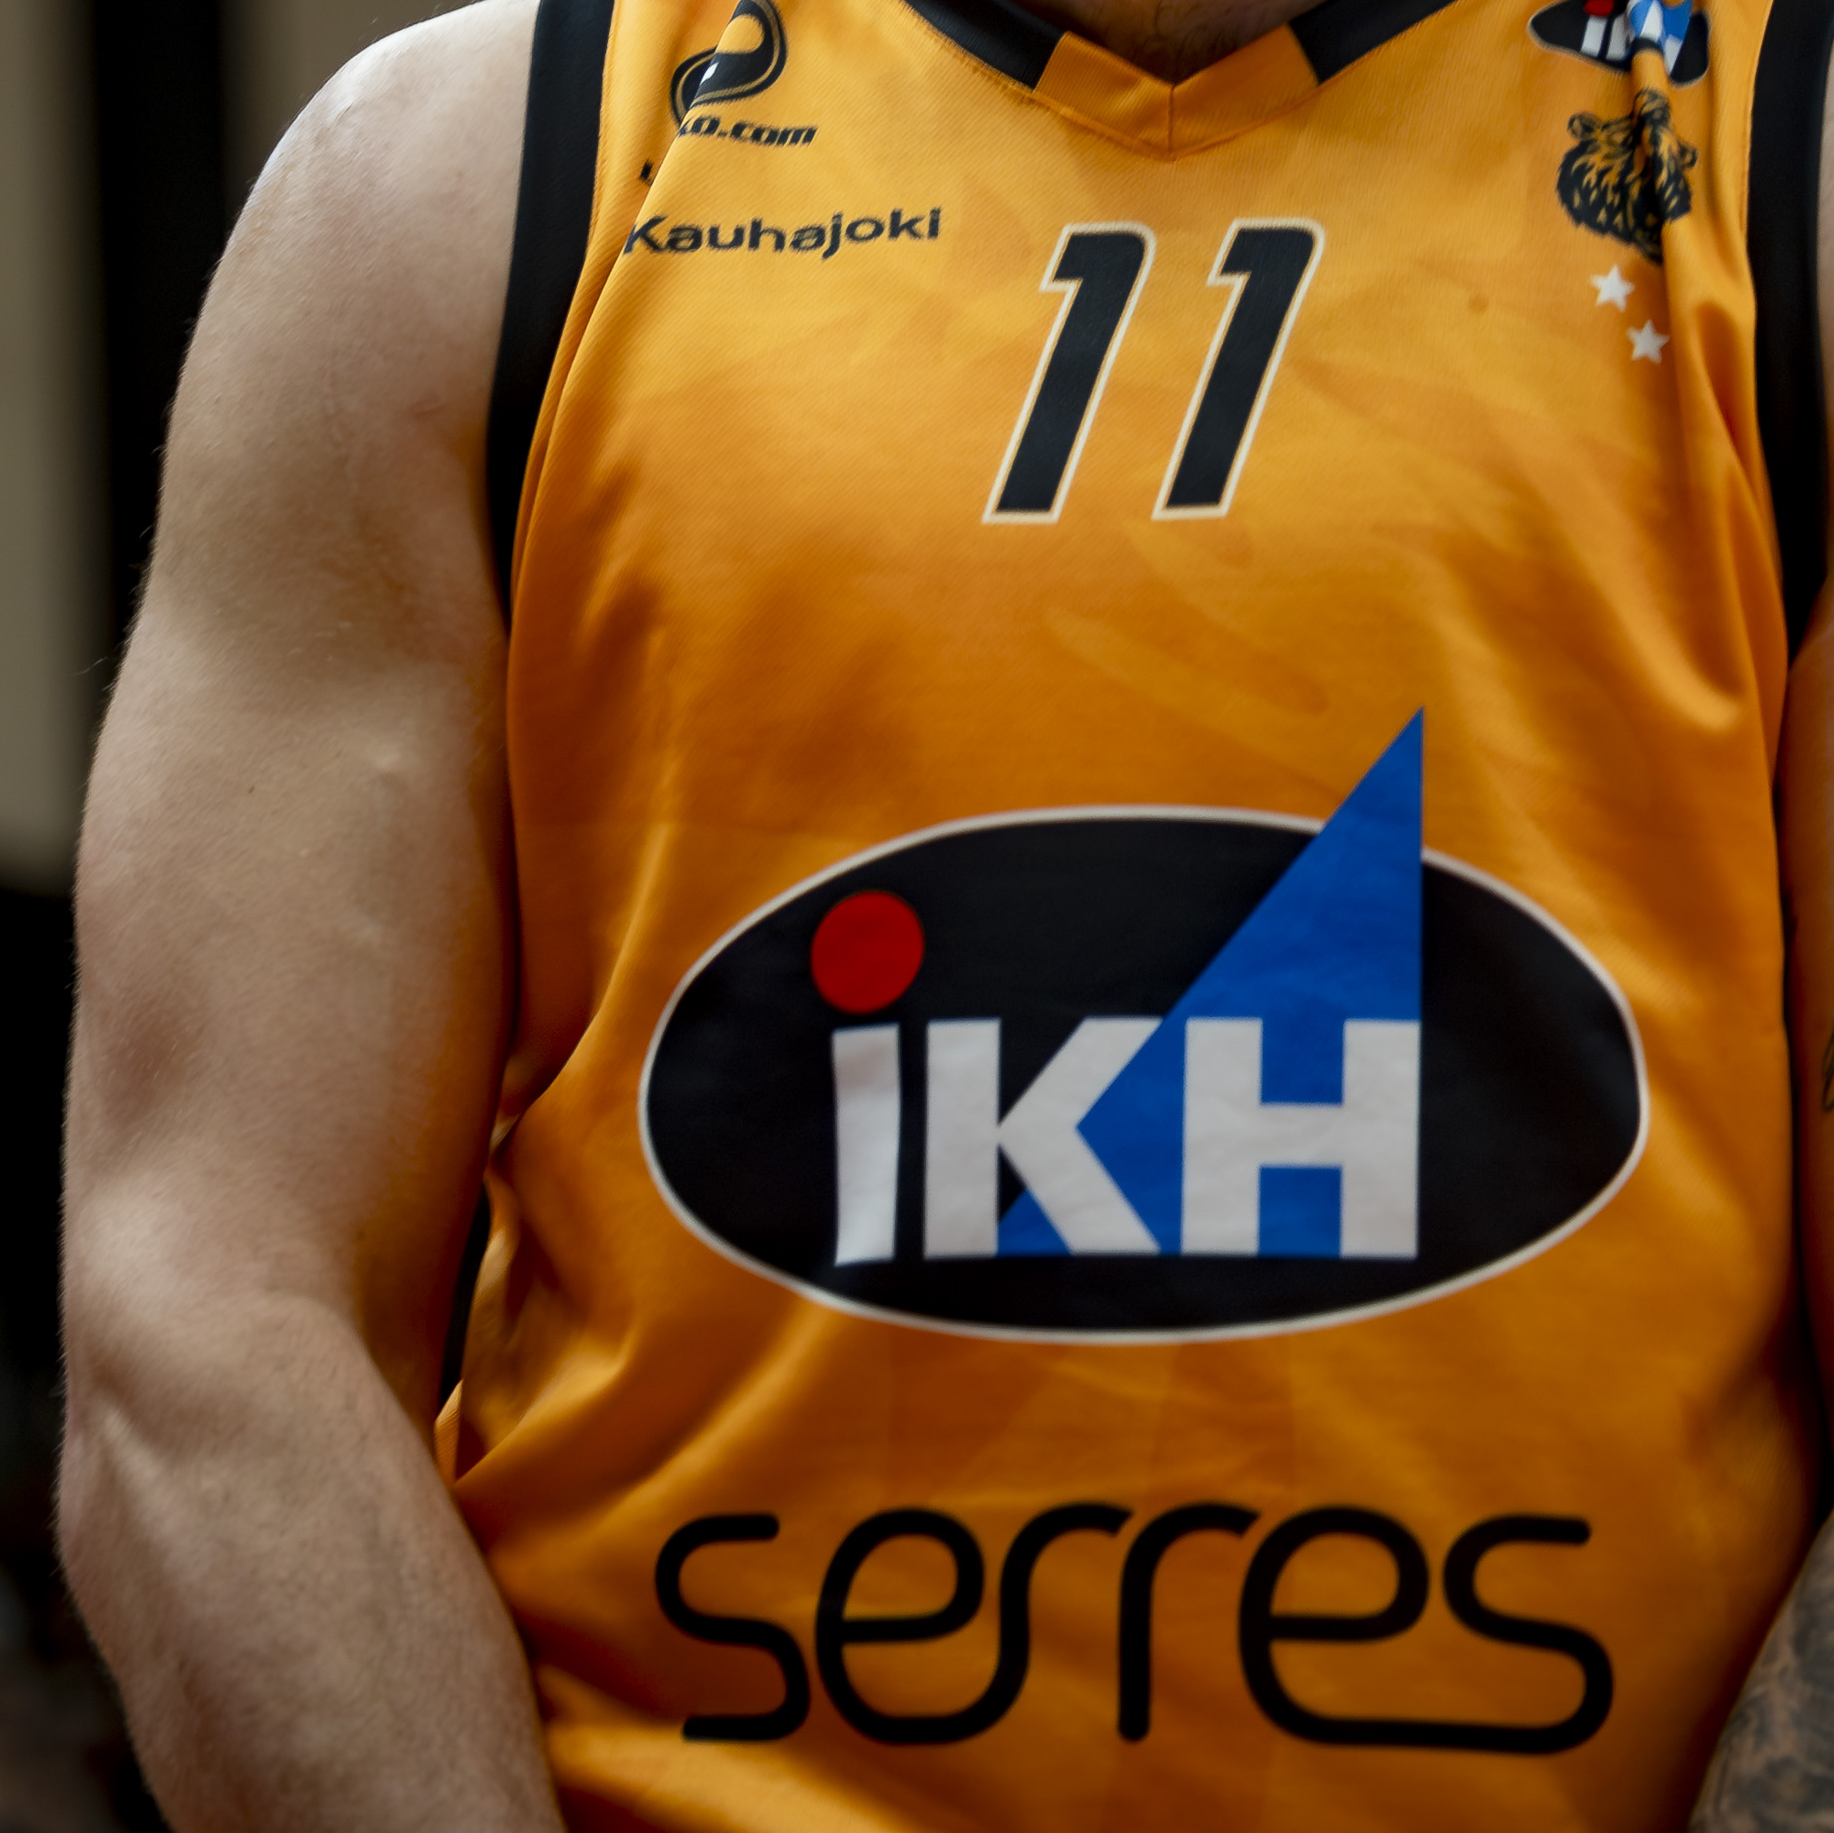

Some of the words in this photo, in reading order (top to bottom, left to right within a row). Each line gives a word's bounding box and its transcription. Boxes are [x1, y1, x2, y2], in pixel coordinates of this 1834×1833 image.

[623, 207, 941, 260] Kauhajoki
[982, 217, 1326, 524] 11
[654, 1502, 1615, 1755] serres
